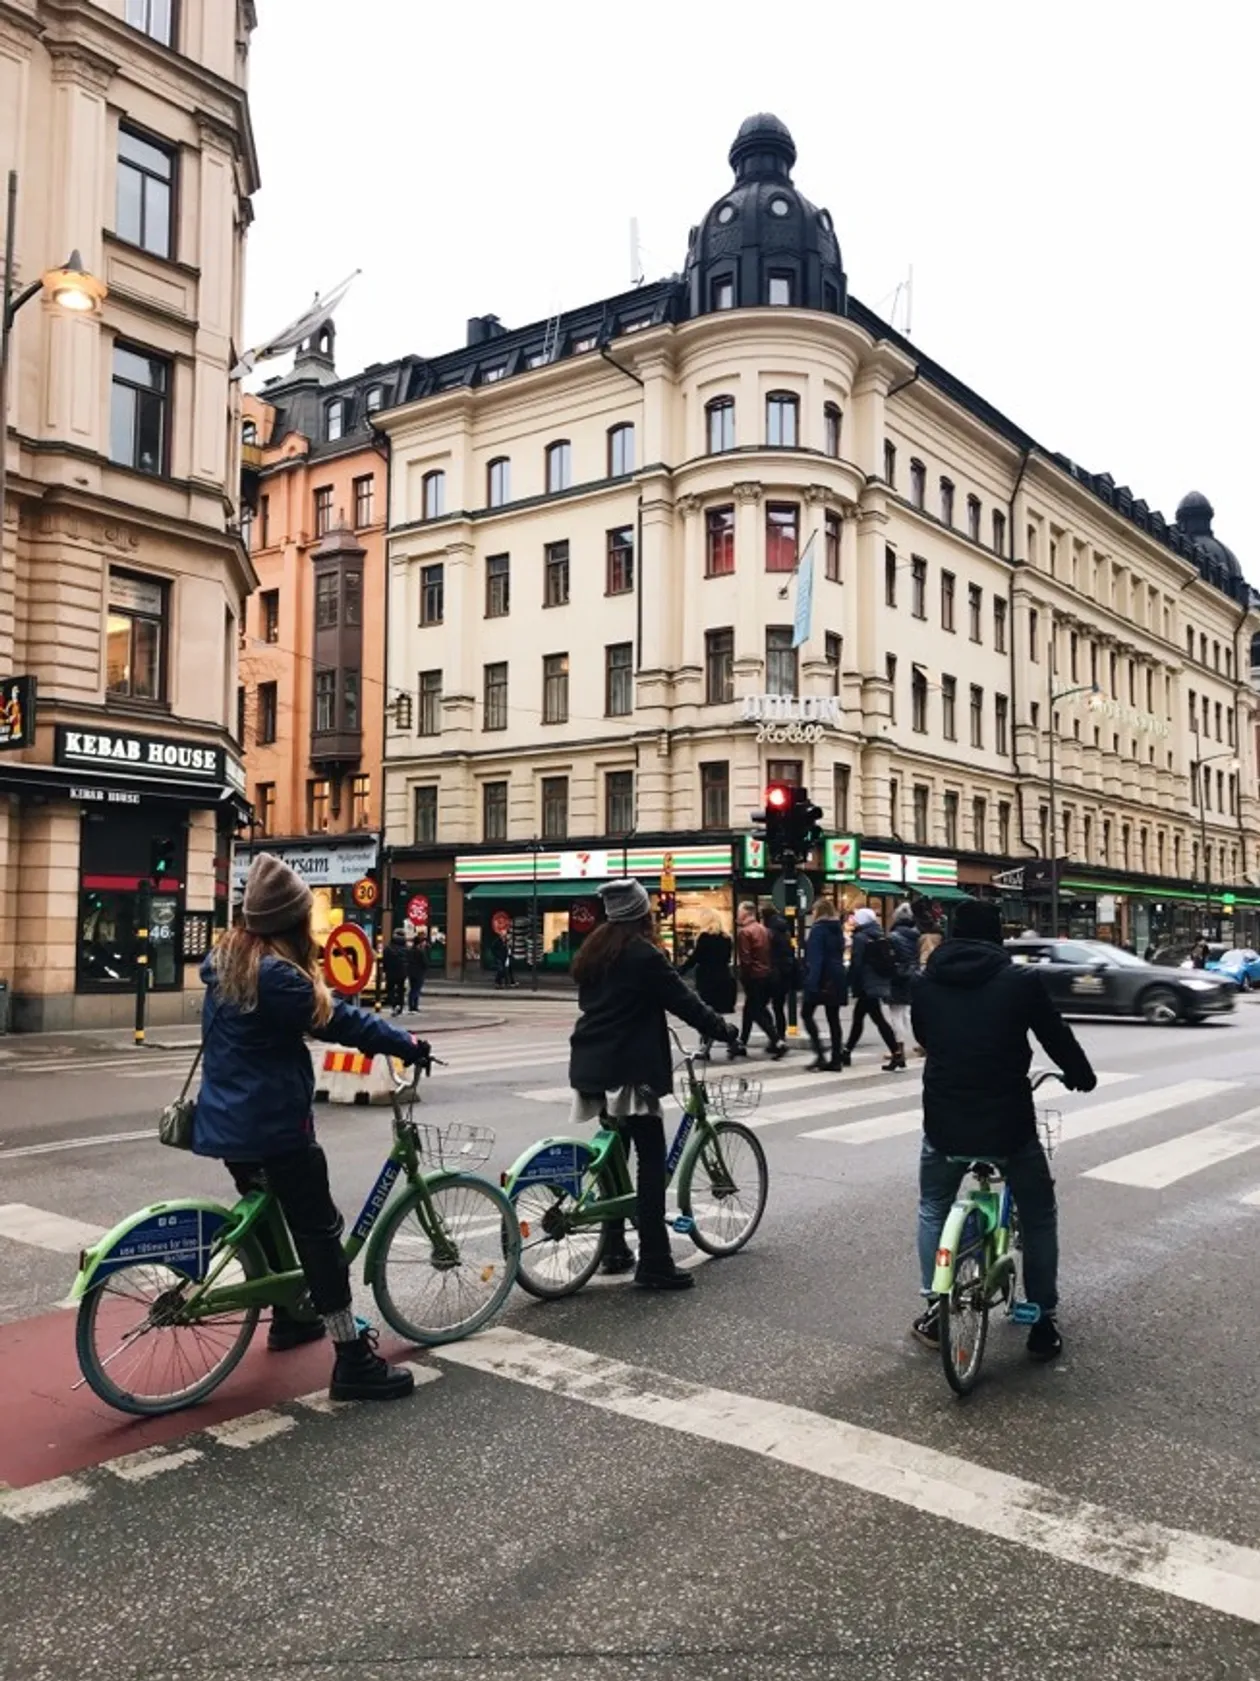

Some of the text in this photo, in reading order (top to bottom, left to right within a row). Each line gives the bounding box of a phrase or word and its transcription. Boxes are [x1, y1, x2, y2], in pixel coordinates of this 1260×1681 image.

[65, 732, 216, 769] KEBAB HOUSE
[70, 787, 141, 803] KEBAB HOUSE
[359, 885, 374, 898] 30
[357, 1167, 398, 1238] EU-BIKE
